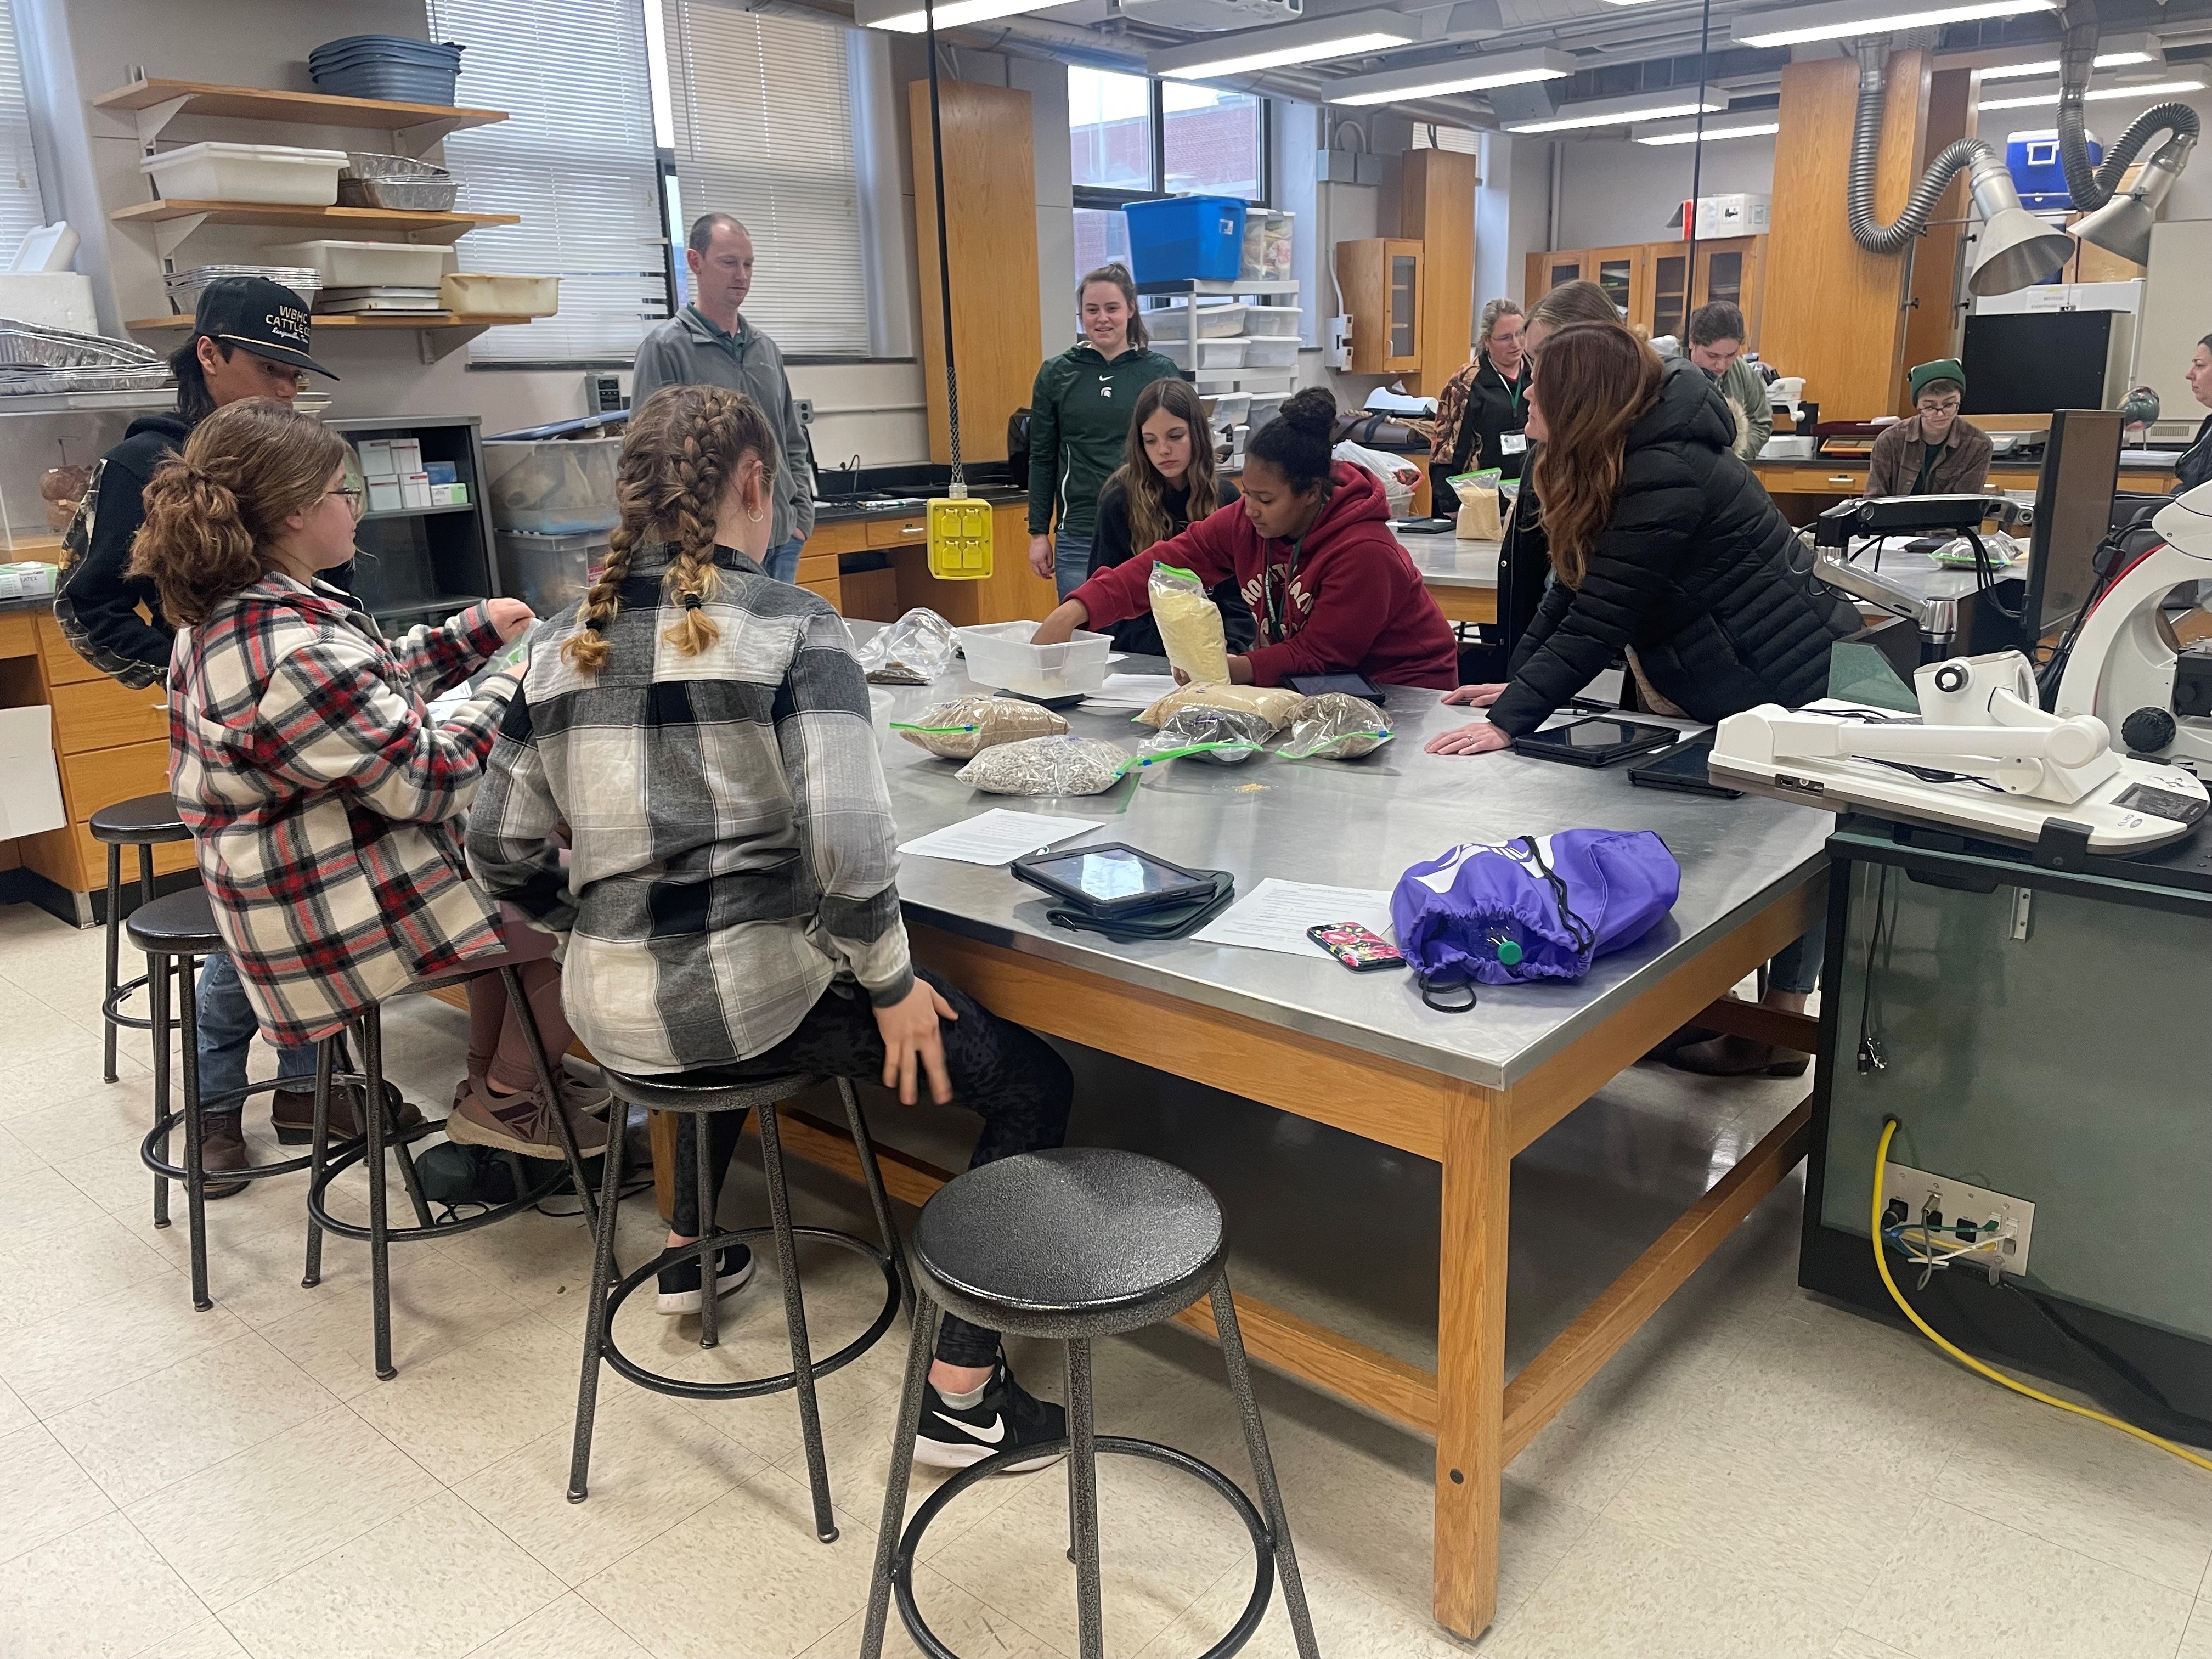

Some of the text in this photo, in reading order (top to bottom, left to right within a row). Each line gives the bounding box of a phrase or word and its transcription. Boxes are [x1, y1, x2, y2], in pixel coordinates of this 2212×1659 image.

[266, 314, 304, 334] CATTLE
[280, 305, 308, 324] WBHC
[2117, 814, 2134, 827] ELMO
